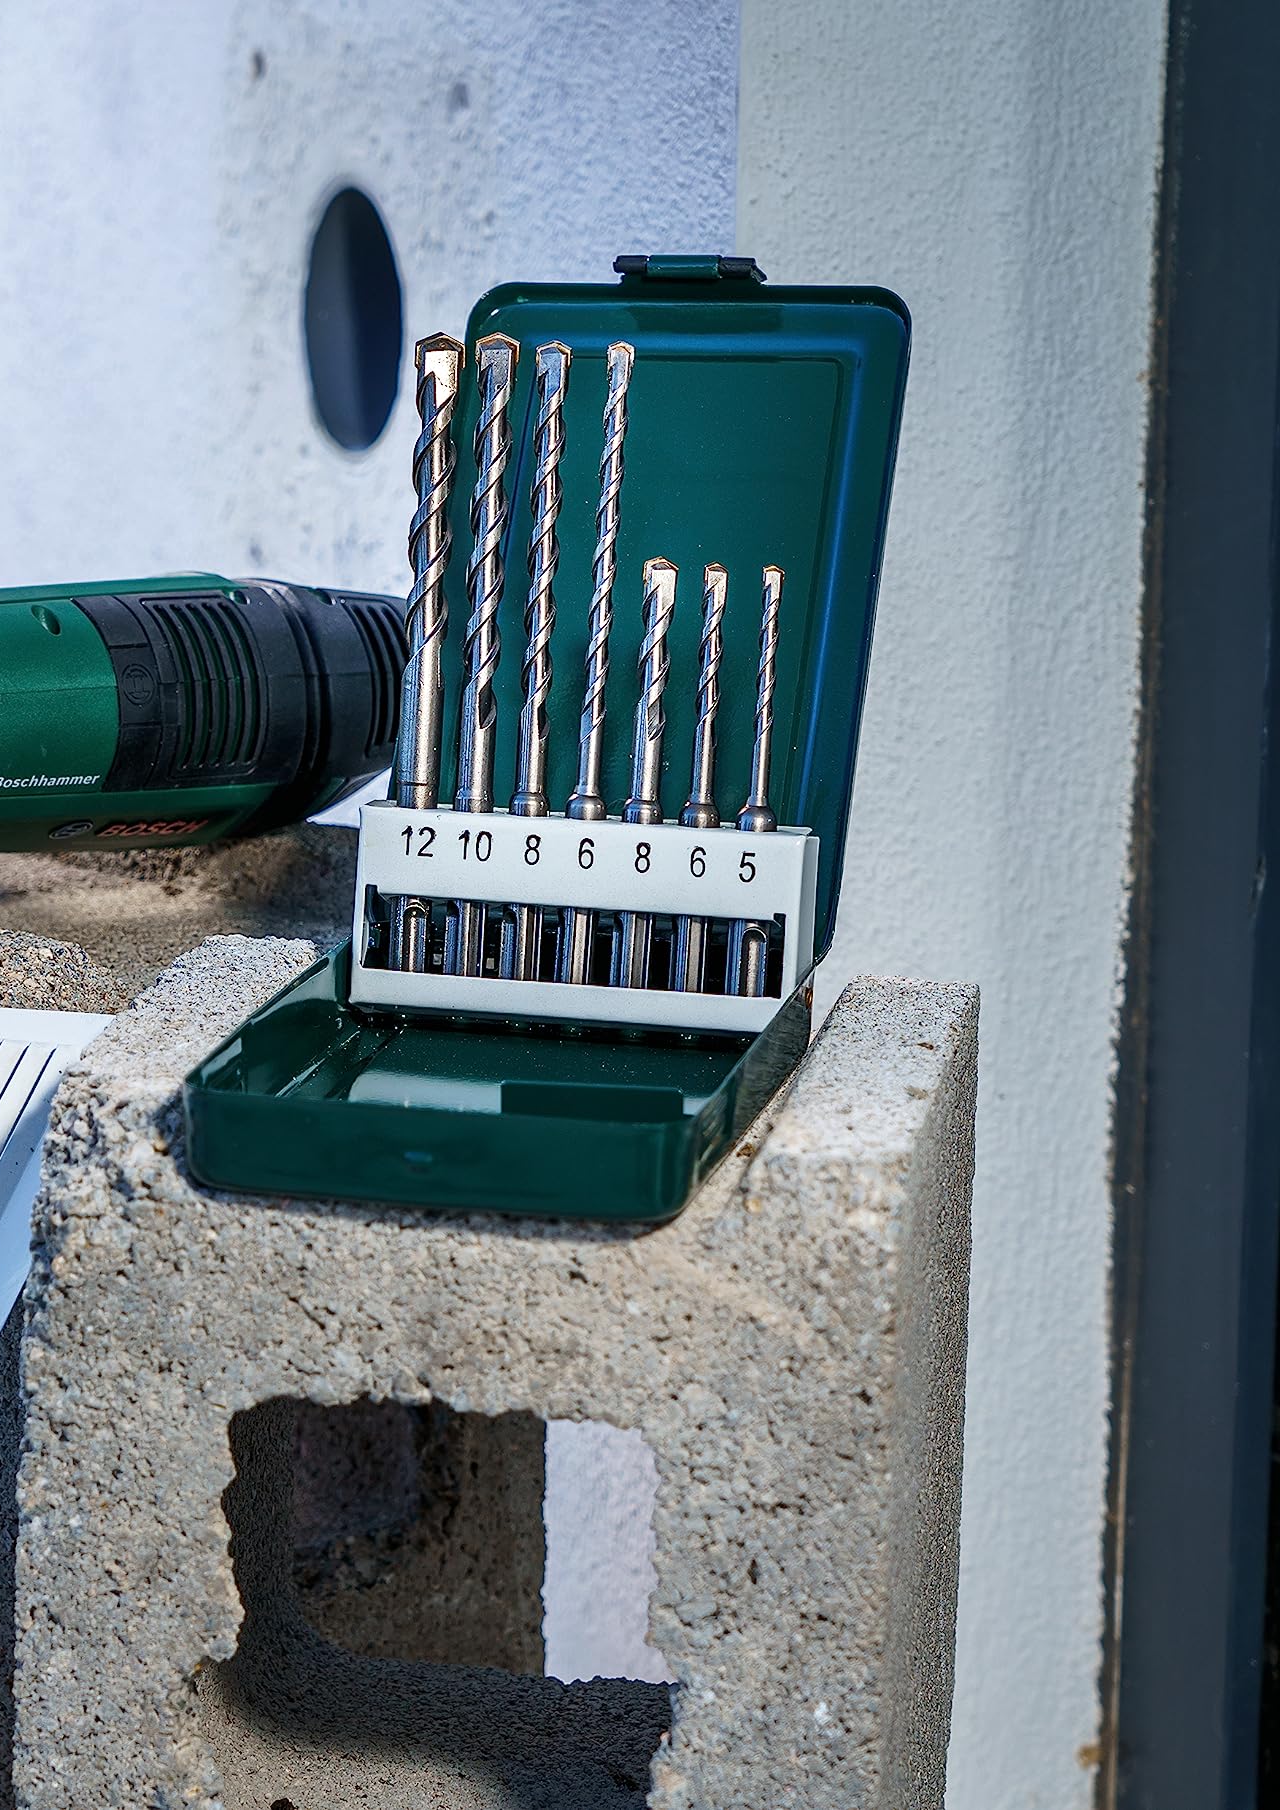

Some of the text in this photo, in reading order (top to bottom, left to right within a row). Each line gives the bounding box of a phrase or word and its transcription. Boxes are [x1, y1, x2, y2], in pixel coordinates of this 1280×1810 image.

[96, 819, 208, 838] BOSCH
[401, 825, 756, 883] 12 10 8 6 8 6 5
